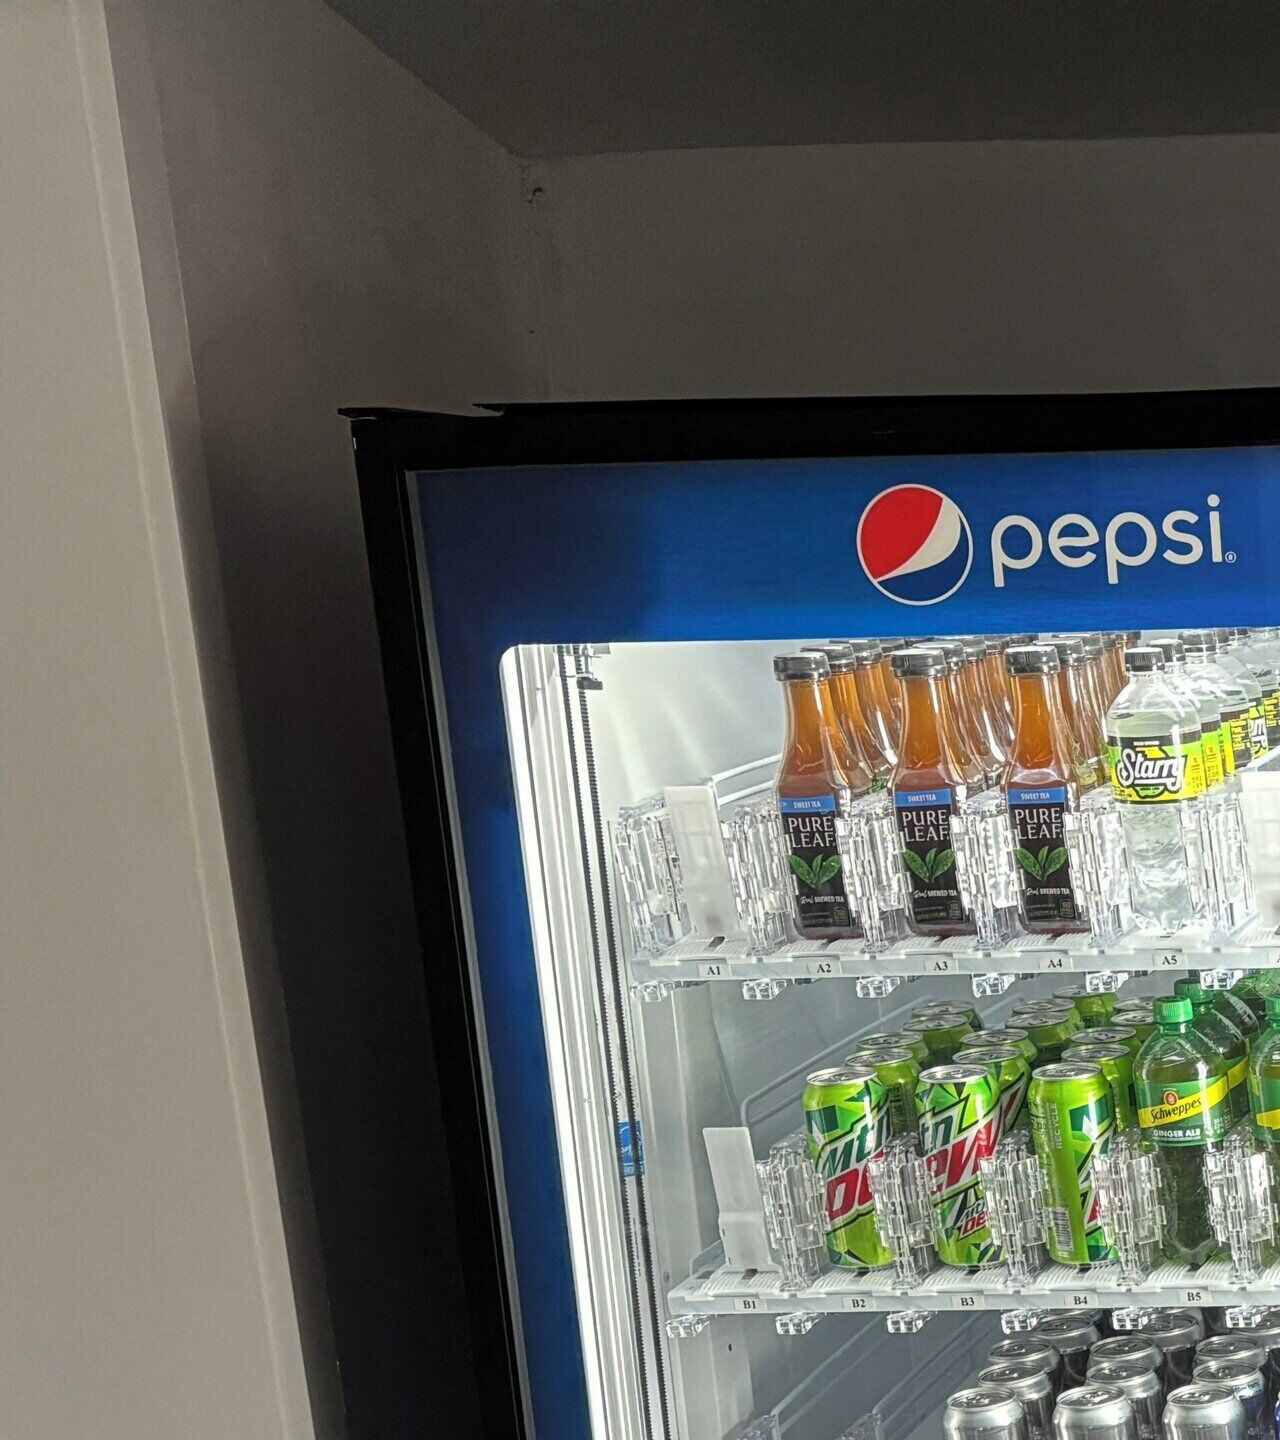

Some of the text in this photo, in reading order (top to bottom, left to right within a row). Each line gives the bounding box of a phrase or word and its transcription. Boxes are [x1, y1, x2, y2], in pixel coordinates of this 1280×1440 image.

[991, 494, 1223, 589] pepsi
[1118, 749, 1186, 790] Starry
[788, 816, 834, 833] PURE
[901, 809, 948, 827] PURE
[1014, 808, 1061, 825] PURE
[790, 832, 834, 848] LEAF
[904, 824, 949, 842] LEAF
[1017, 823, 1062, 840] LEAF
[816, 963, 832, 974] A2
[1047, 959, 1063, 969] A4
[1150, 1096, 1202, 1124] Schweppes
[1152, 1127, 1200, 1137] GINGER ALE
[852, 1299, 866, 1308] B2
[961, 1297, 975, 1305] B3
[1187, 1291, 1201, 1301] B5
